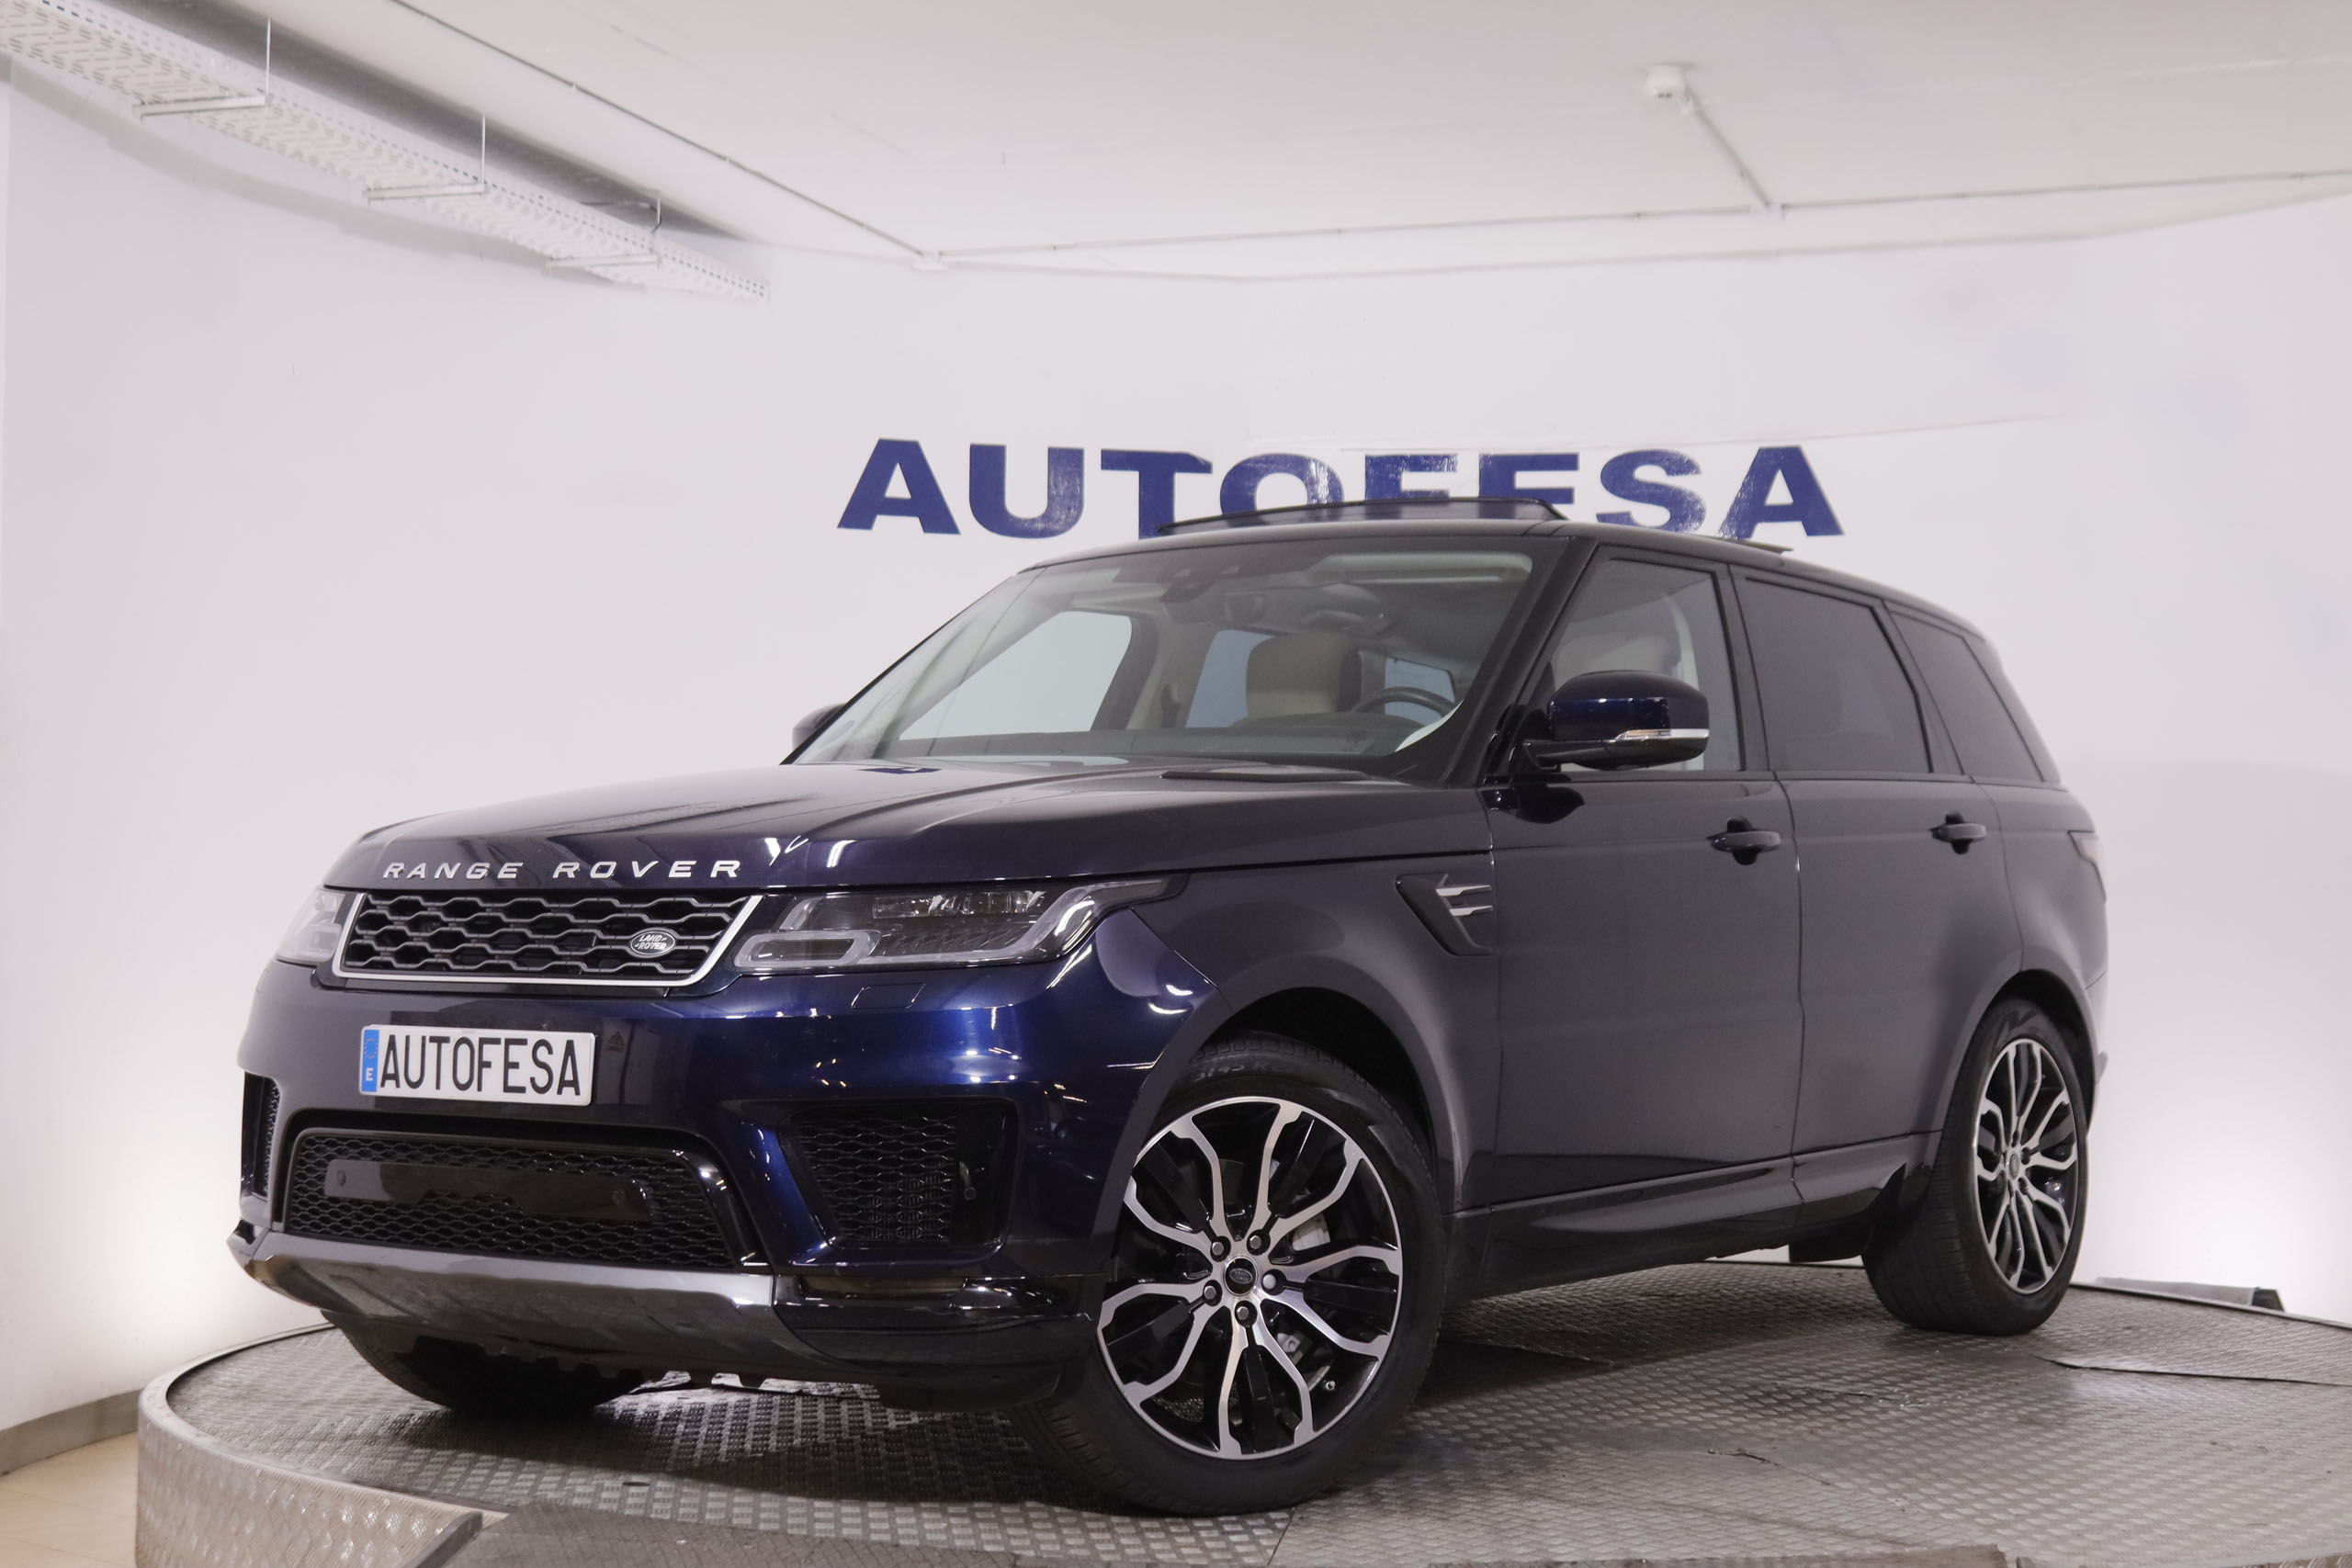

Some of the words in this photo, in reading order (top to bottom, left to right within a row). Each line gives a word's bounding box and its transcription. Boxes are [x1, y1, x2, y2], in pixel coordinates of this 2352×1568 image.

[382, 862, 524, 880] RANGE
[552, 860, 741, 879] ROVER
[366, 1066, 375, 1082] E
[379, 1034, 581, 1097] AUTOFESA
